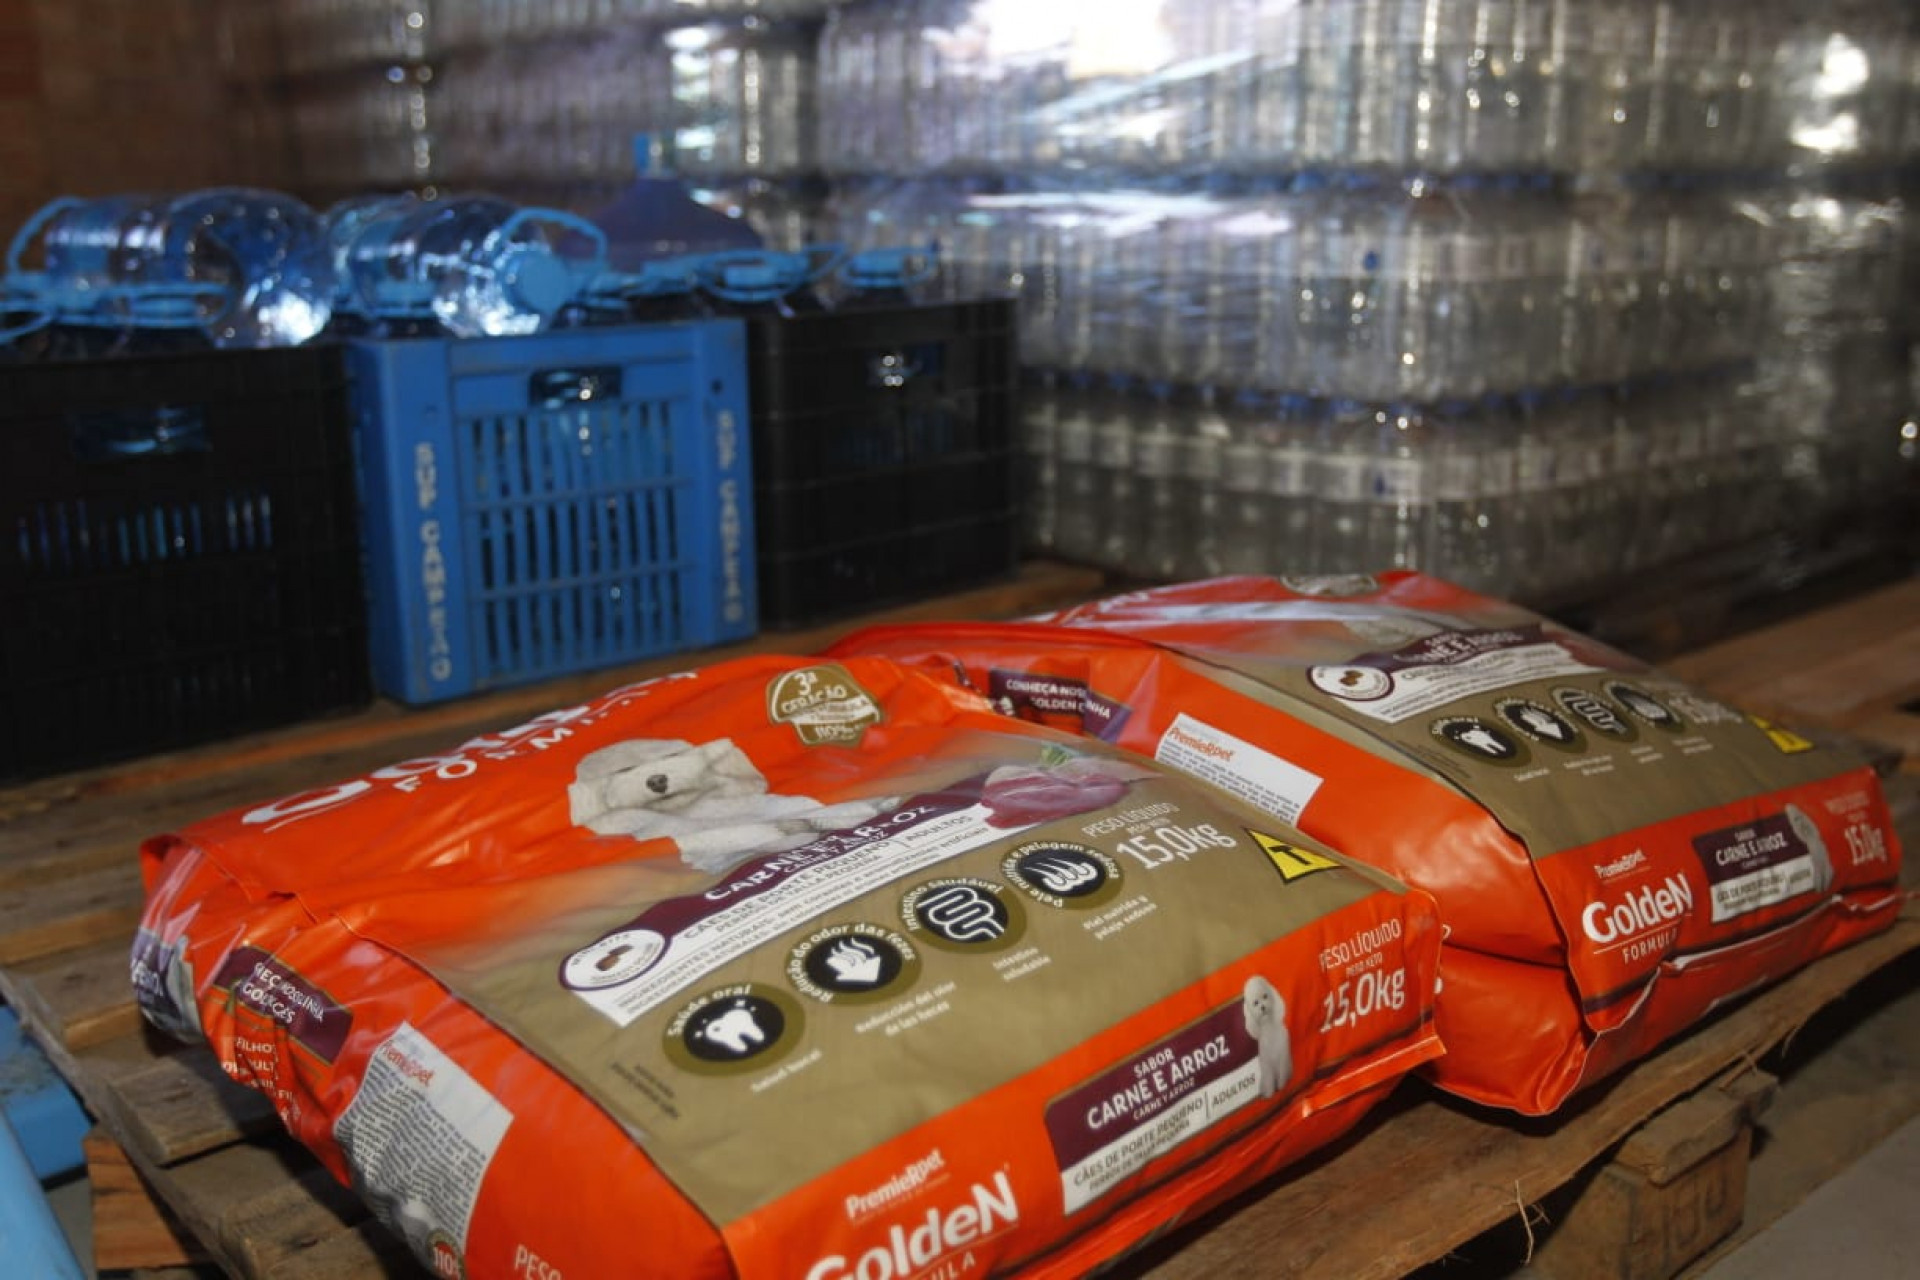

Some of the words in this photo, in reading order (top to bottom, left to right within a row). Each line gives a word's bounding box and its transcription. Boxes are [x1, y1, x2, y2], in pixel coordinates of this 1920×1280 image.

[1117, 823, 1237, 869] 15,0kg
[1581, 871, 1694, 943] GoldeN
[810, 924, 848, 943] odor
[854, 922, 886, 937] das
[1350, 918, 1402, 957] LÍQUIDO
[712, 984, 752, 1000] oral
[1319, 967, 1406, 1034] 15,0kg
[1086, 1078, 1154, 1130] CARNE
[1152, 1069, 1168, 1094] E
[1170, 1034, 1231, 1085] ARROZ
[1133, 1047, 1176, 1078] SABOR
[1105, 1151, 1120, 1169] DE
[1211, 1072, 1257, 1107] ADULTOS
